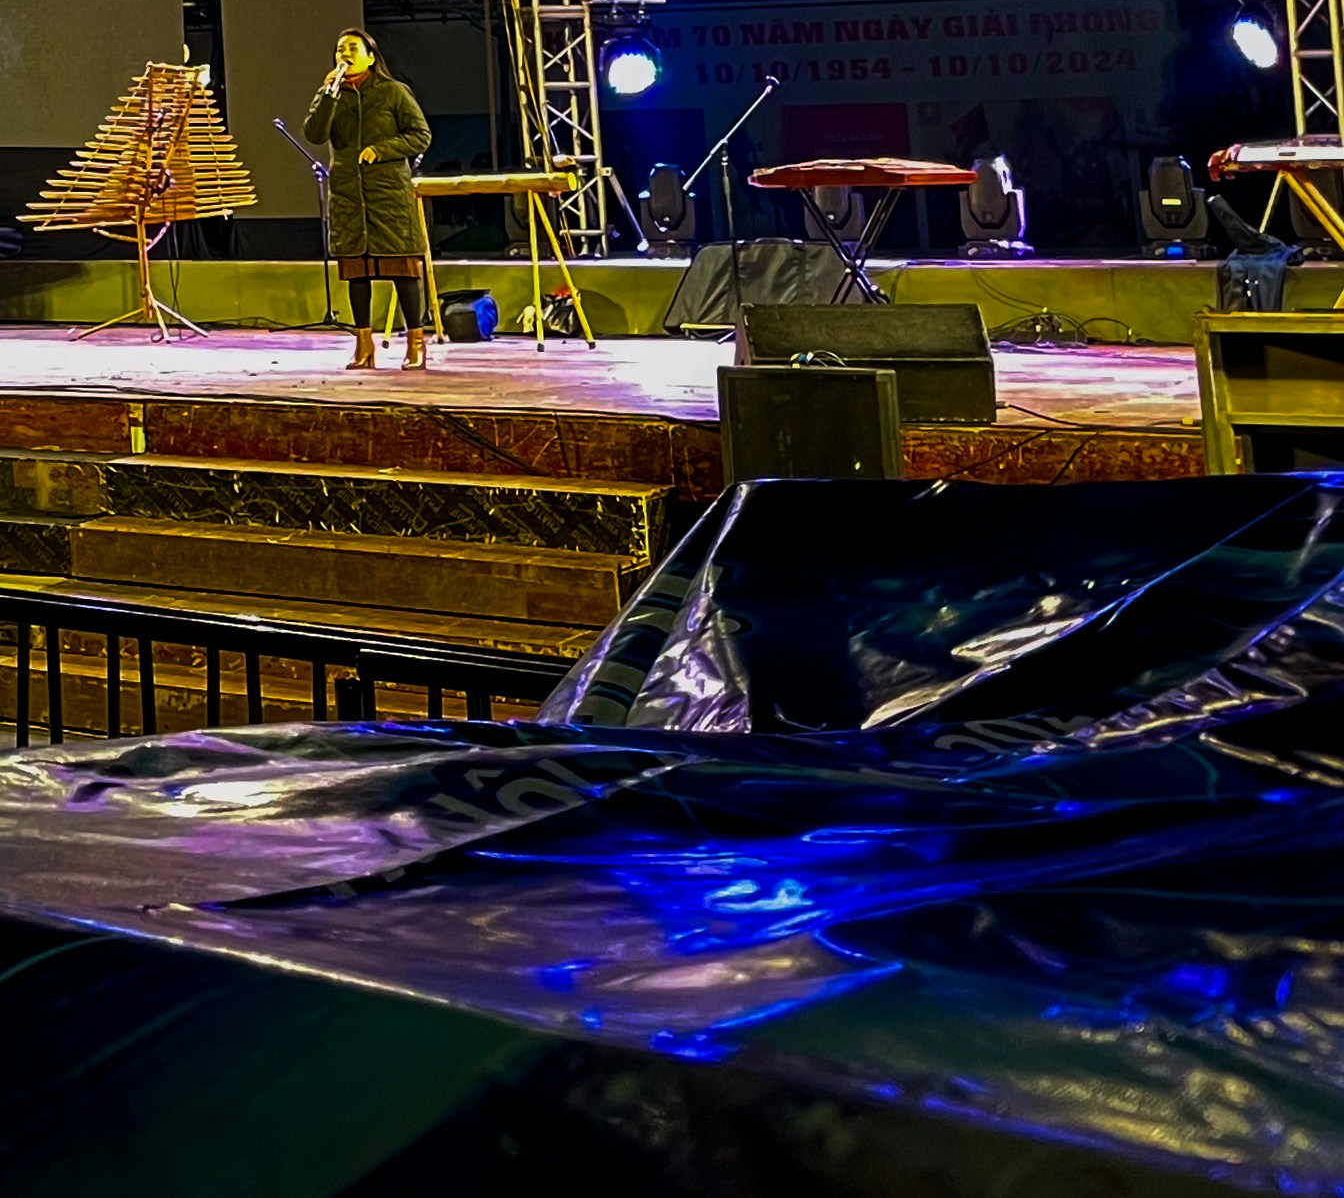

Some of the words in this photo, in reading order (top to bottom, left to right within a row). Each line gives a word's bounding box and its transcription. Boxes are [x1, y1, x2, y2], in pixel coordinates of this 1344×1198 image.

[691, 26, 732, 48] 70
[740, 15, 825, 46] NĂM
[833, 14, 933, 43] NGÀY
[695, 57, 892, 86] 10/10/1954
[928, 48, 1138, 79] 10/10/2024
